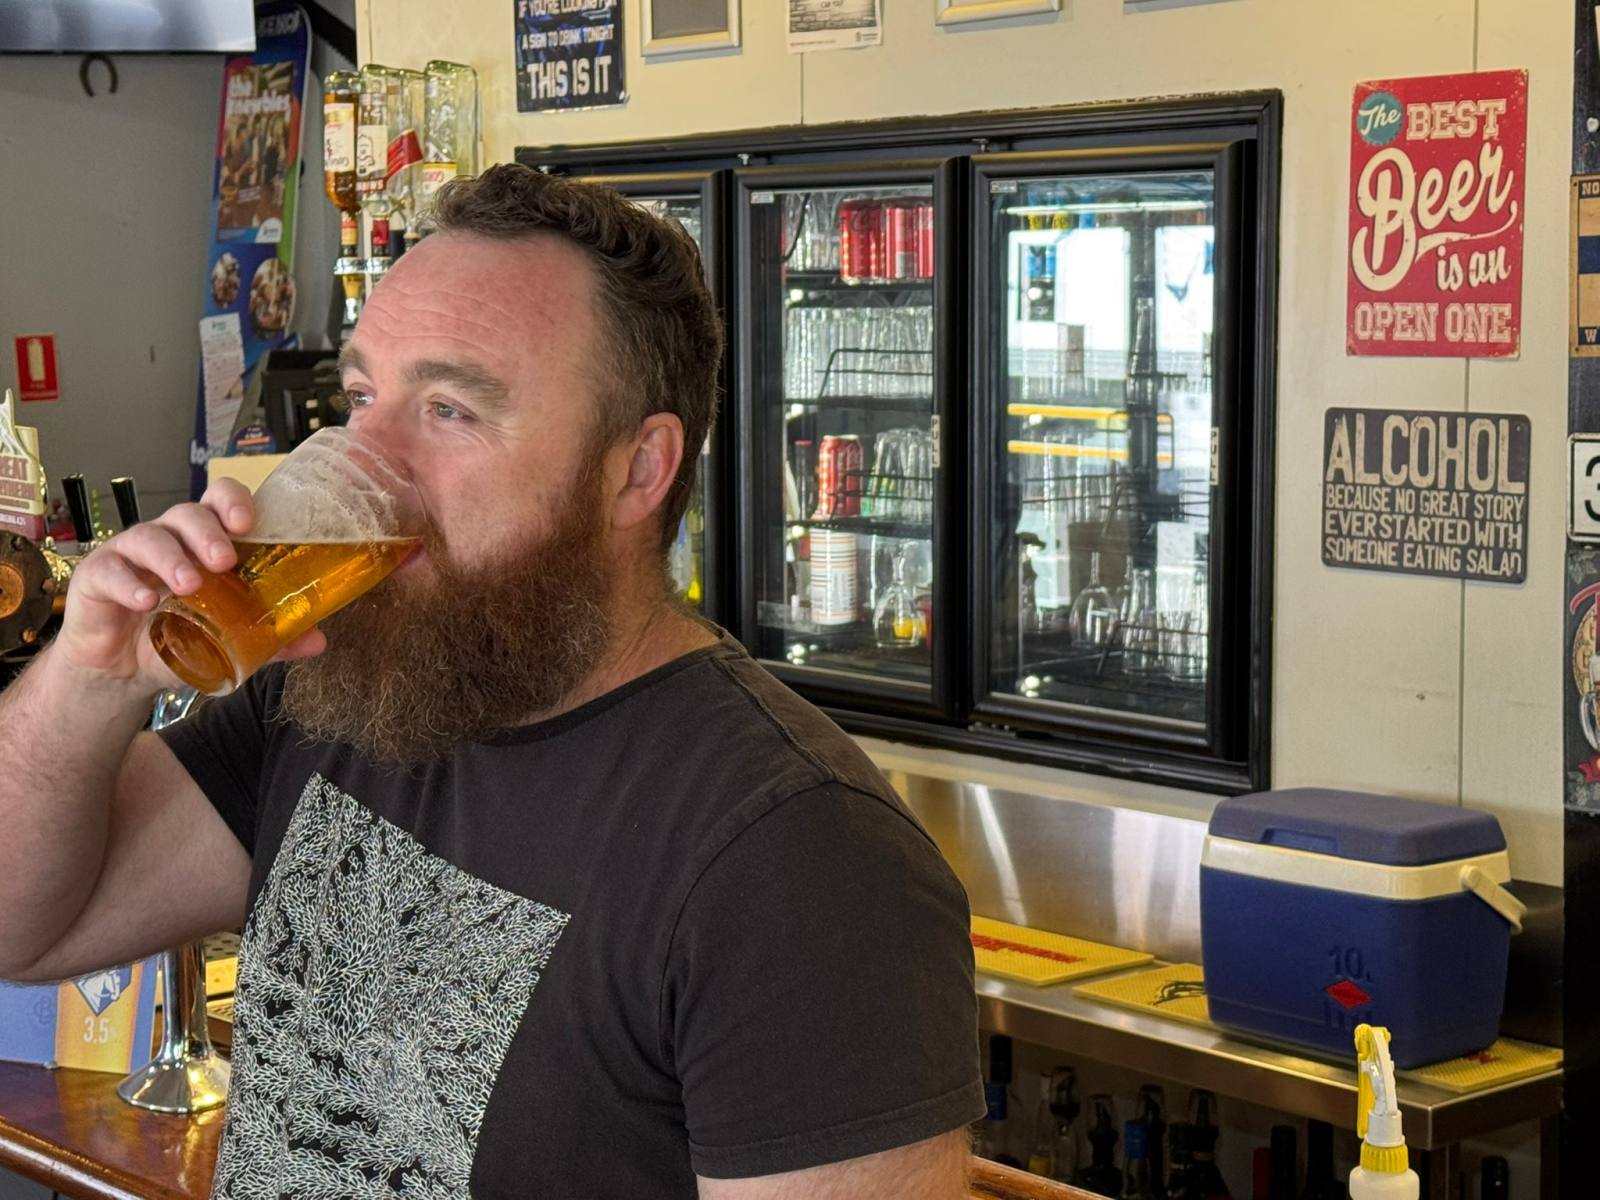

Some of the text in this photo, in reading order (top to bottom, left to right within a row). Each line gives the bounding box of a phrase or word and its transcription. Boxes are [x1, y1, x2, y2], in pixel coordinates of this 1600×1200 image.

[522, 34, 528, 50] A
[548, 31, 558, 47] TO
[527, 55, 612, 99] THIS IS IT
[1357, 99, 1506, 141] The BEST
[1352, 142, 1515, 292] Beer
[1437, 245, 1512, 292] is an
[1354, 302, 1512, 343] OPEN ONE
[1326, 413, 1525, 494] ALCOHOL
[1326, 484, 1525, 522] BECAUSE NO GREAT STORY
[1325, 510, 1523, 550] EVER STARTED WITH
[1325, 537, 1522, 577] SOMEONE EATING SALAD
